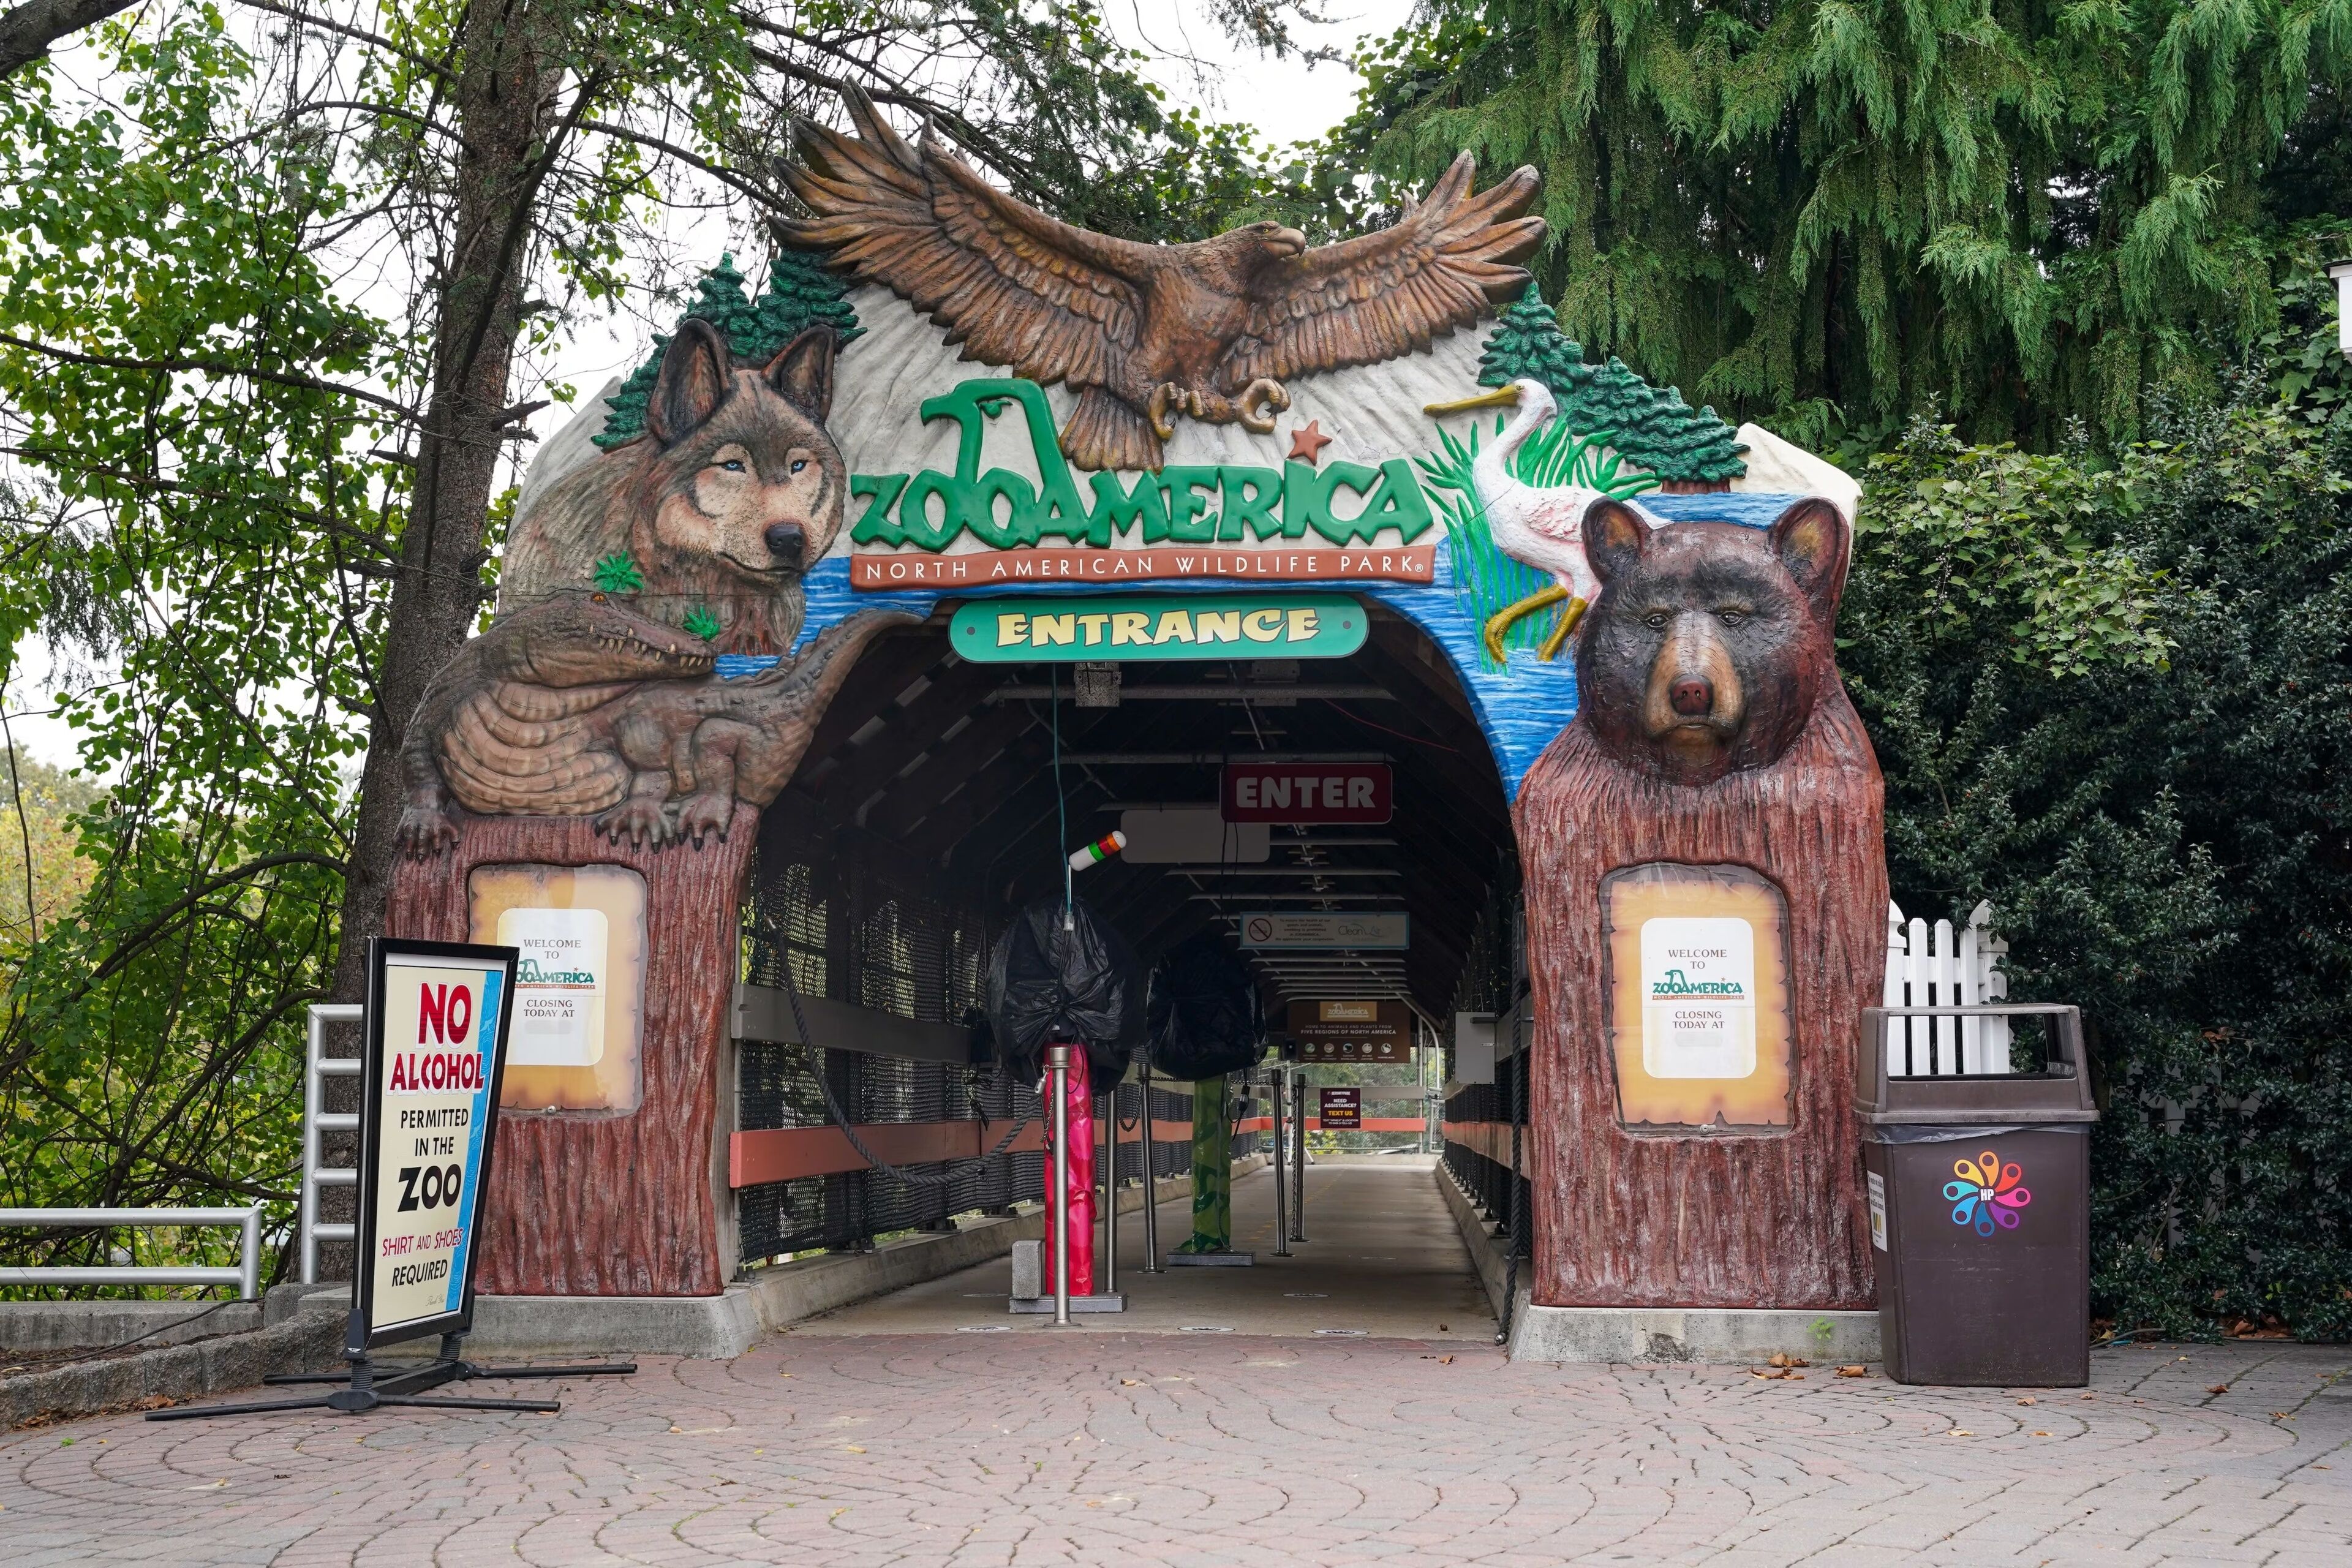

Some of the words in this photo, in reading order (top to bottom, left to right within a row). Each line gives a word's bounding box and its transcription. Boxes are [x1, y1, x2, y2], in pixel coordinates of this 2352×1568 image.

[850, 378, 1434, 553] ZOOAMERICA
[866, 560, 967, 579] NORTH
[992, 557, 1153, 577] AMERICAN
[1175, 556, 1318, 574] WILDLIFE
[995, 608, 1321, 648] ENTRANCE
[1236, 777, 1376, 809] ENTER
[524, 939, 581, 948] WELCOME
[545, 951, 559, 959] TO
[1668, 949, 1727, 958] WELCOME
[515, 959, 594, 983] OOAMERICA
[1653, 970, 1743, 994] ZOOAMERICA
[418, 982, 472, 1044] NO
[389, 1052, 484, 1091] ALCOHOL
[401, 1108, 469, 1128] PERMITTED
[415, 1137, 429, 1156] IN
[433, 1136, 454, 1155] THE
[397, 1164, 462, 1213] ZOO
[1980, 1188, 1994, 1201] HP
[382, 1235, 414, 1257] SHIRT
[416, 1234, 431, 1251] AND
[434, 1228, 464, 1250] SHOES
[391, 1259, 448, 1287] REQUIRED
